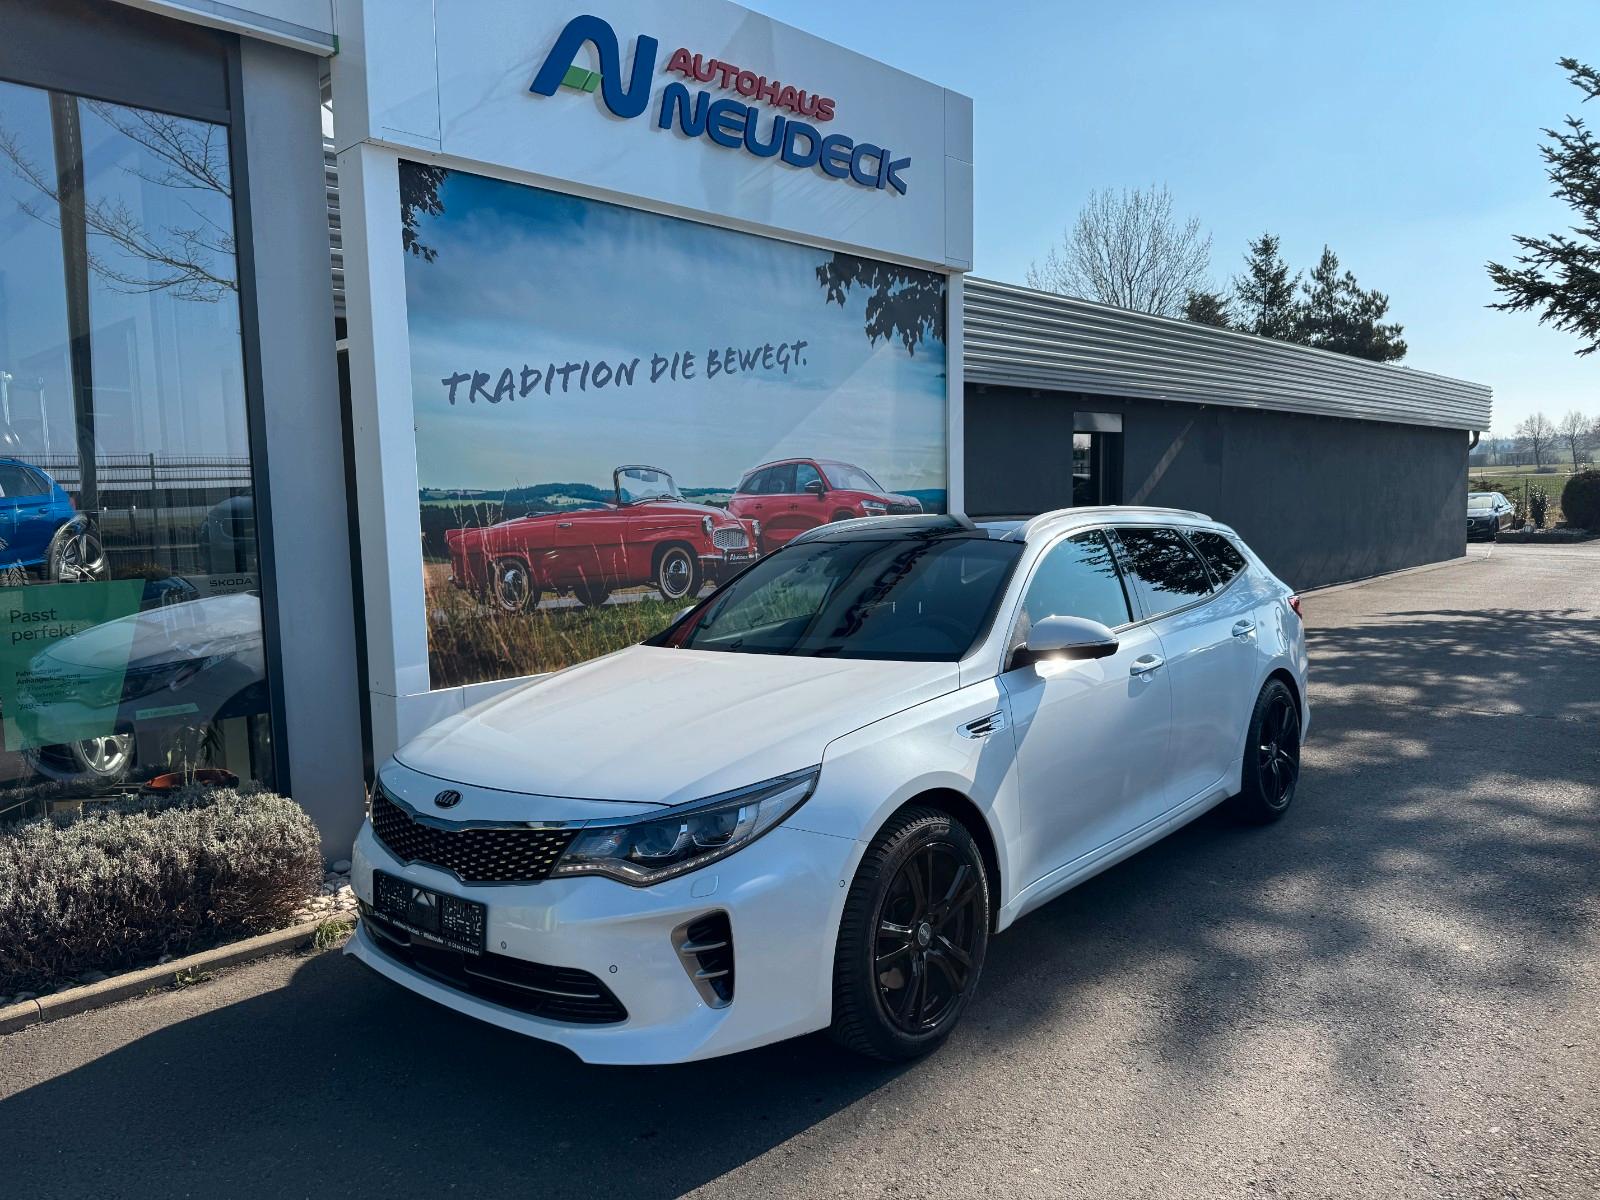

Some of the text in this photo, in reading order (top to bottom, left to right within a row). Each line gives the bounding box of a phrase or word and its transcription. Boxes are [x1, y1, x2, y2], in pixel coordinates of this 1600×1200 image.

[666, 47, 836, 122] AUTOHAUS
[659, 82, 911, 195] NEUDECK
[441, 340, 808, 406] TRADITION DIE BEWEGT.
[10, 608, 57, 624] Passt
[11, 624, 77, 646] perfekt
[436, 791, 457, 805] KIA
